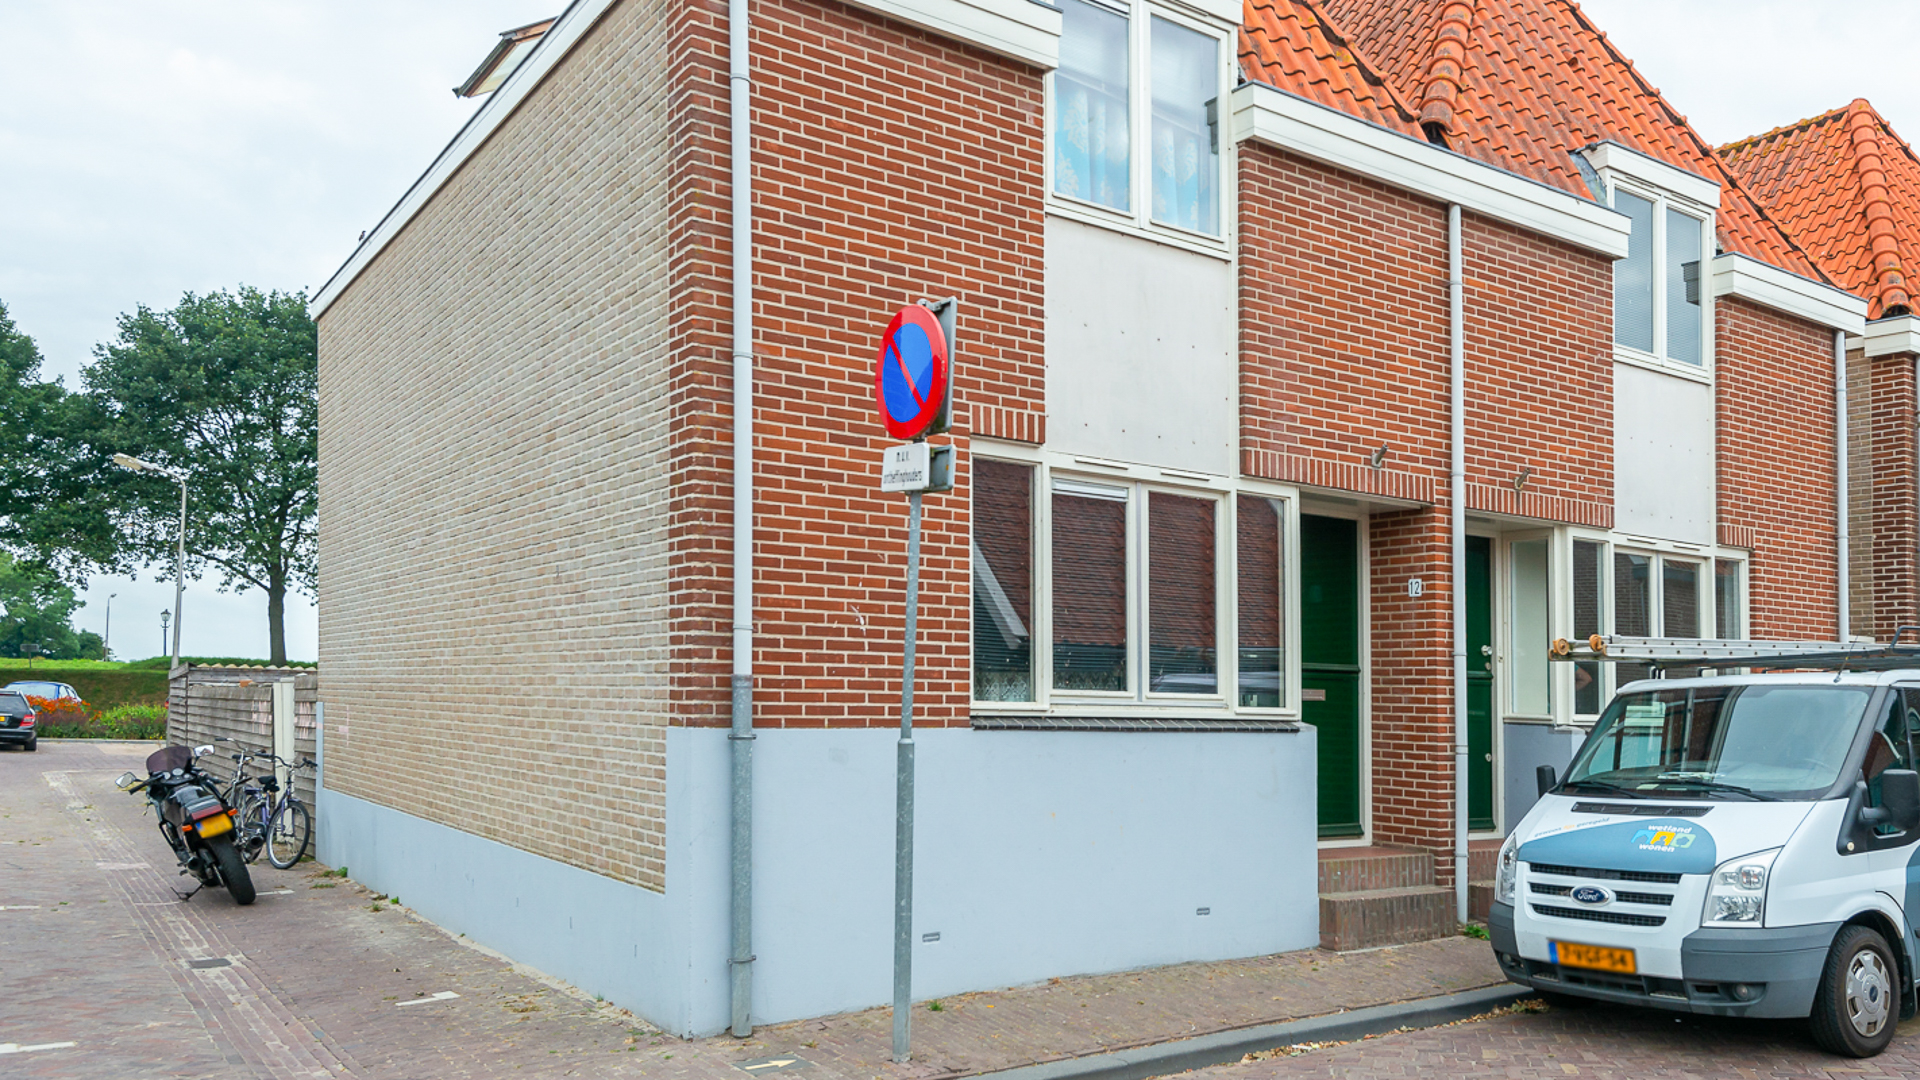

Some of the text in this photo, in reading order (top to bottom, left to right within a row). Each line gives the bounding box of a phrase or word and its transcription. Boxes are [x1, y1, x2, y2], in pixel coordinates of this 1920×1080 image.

[1409, 581, 1419, 594] 12
[1648, 825, 1693, 834] wetland
[1639, 844, 1675, 853] wonen
[1578, 889, 1600, 901] Ford
